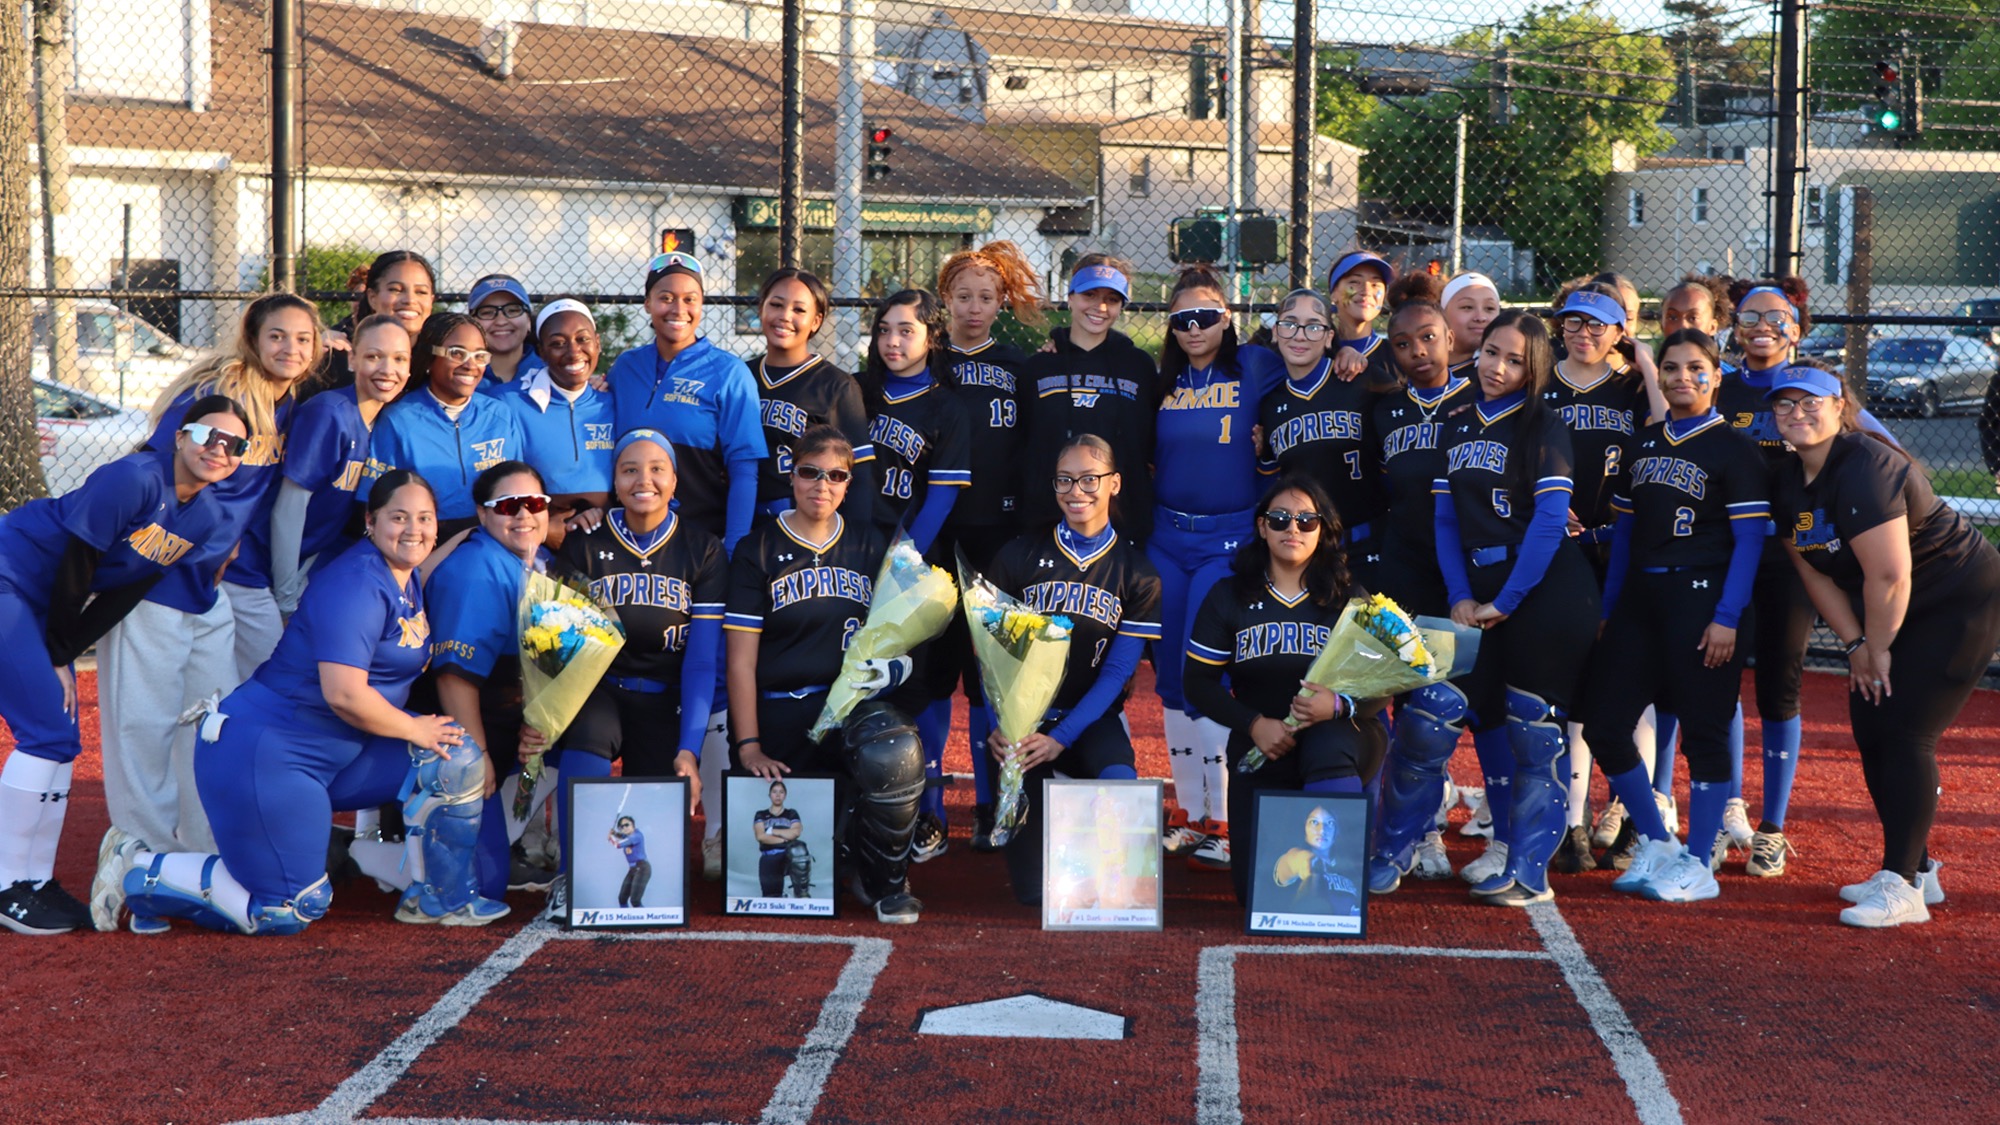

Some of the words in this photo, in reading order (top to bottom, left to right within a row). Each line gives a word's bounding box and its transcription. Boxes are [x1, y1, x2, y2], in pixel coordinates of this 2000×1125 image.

[664, 393, 700, 406] SOFTBALL
[990, 398, 1017, 428] 13
[760, 398, 808, 439] RESS
[1218, 414, 1231, 444] 1
[1269, 411, 1362, 458] EXPRESS
[1343, 449, 1363, 480] 7
[882, 466, 914, 499] 18
[1492, 488, 1512, 518] 5
[1673, 506, 1695, 536] 2
[588, 573, 692, 615] EXPRESS
[771, 566, 873, 612] EXPRESS
[1023, 581, 1123, 631] EXPRESS
[435, 639, 476, 660] EXPRESS
[662, 623, 691, 652] 15
[1235, 622, 1331, 664] EXPRES
